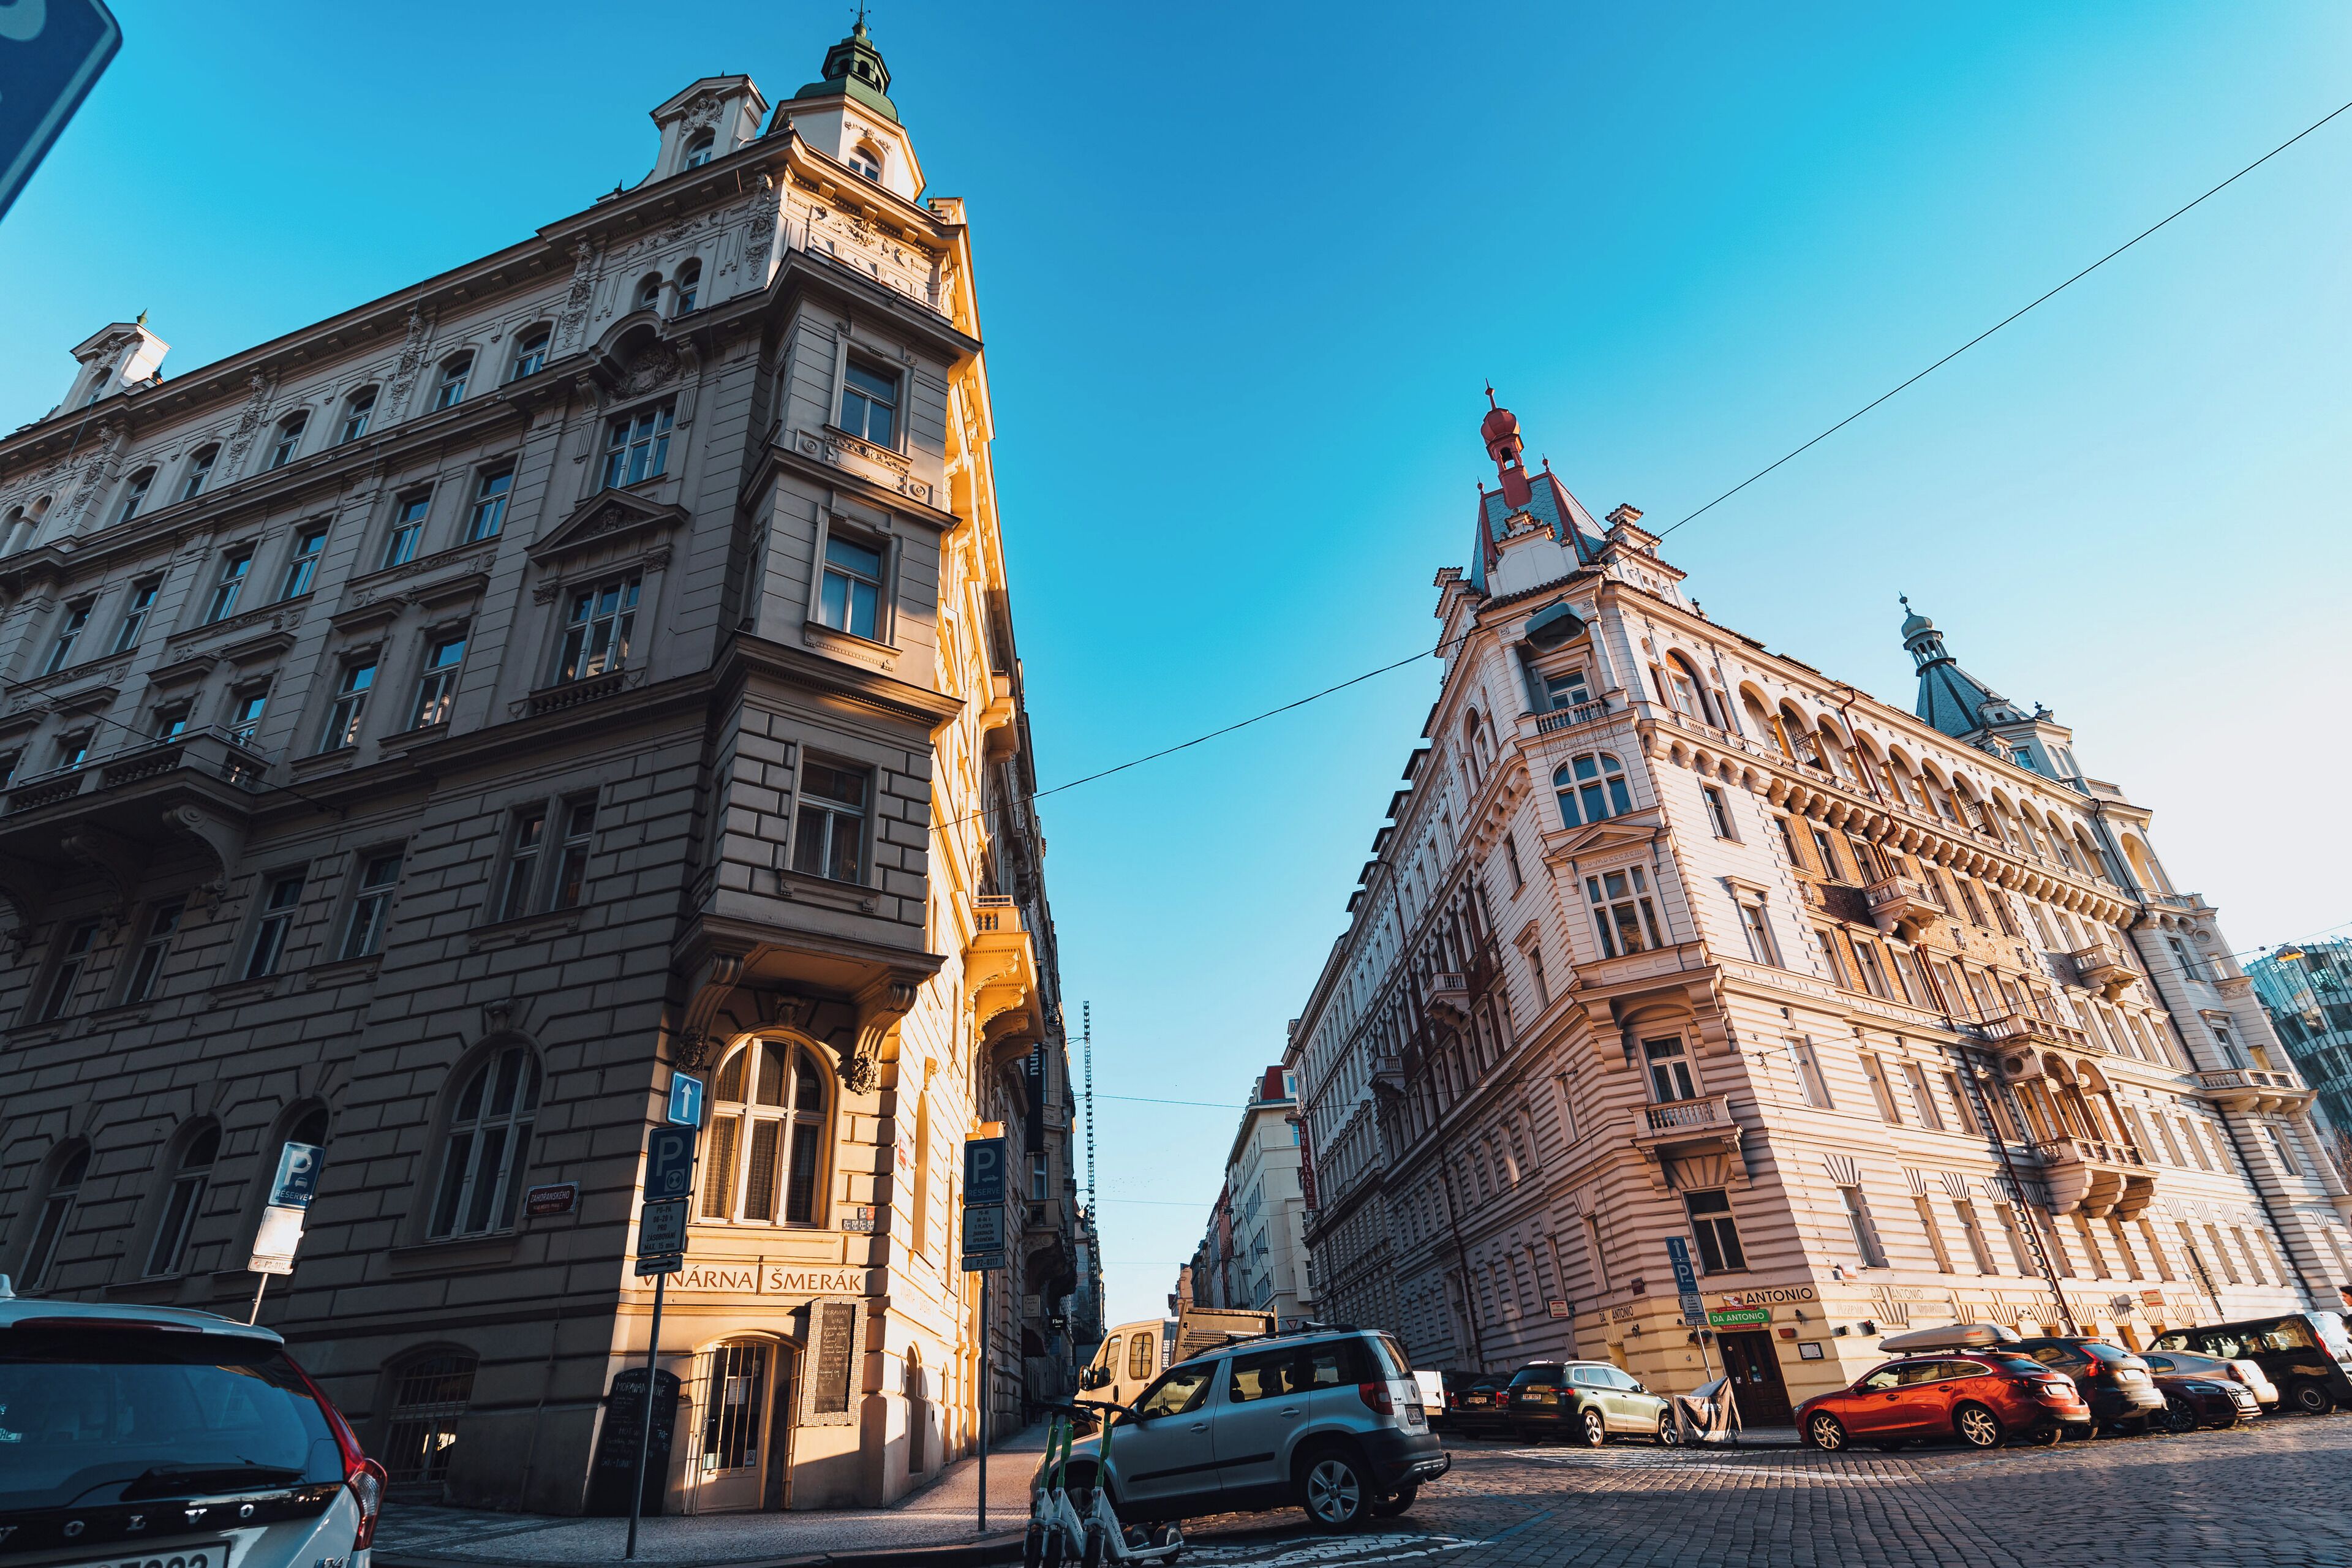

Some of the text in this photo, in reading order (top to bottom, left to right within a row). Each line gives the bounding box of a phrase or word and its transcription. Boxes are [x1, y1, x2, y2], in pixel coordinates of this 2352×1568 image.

[656, 1136, 683, 1176] P
[284, 1150, 313, 1185] P
[973, 1148, 996, 1184] P
[1303, 1152, 1313, 1194] PALACE
[657, 1204, 672, 1214] PO-PÁ
[647, 1231, 676, 1242] ZÁSOBOVÁNÍ
[976, 1257, 998, 1267] P2-0117
[643, 1265, 861, 1291] VNÁRNA ŠMERÁK
[1678, 1265, 1689, 1283] P
[1746, 1288, 1813, 1304] ANTONIO
[1871, 1288, 1924, 1299] DA ANTONIO
[1599, 1306, 1634, 1322] DA ANTONIO
[1727, 1313, 1764, 1321] ANTONIO
[0, 1504, 254, 1543] VOLVO
